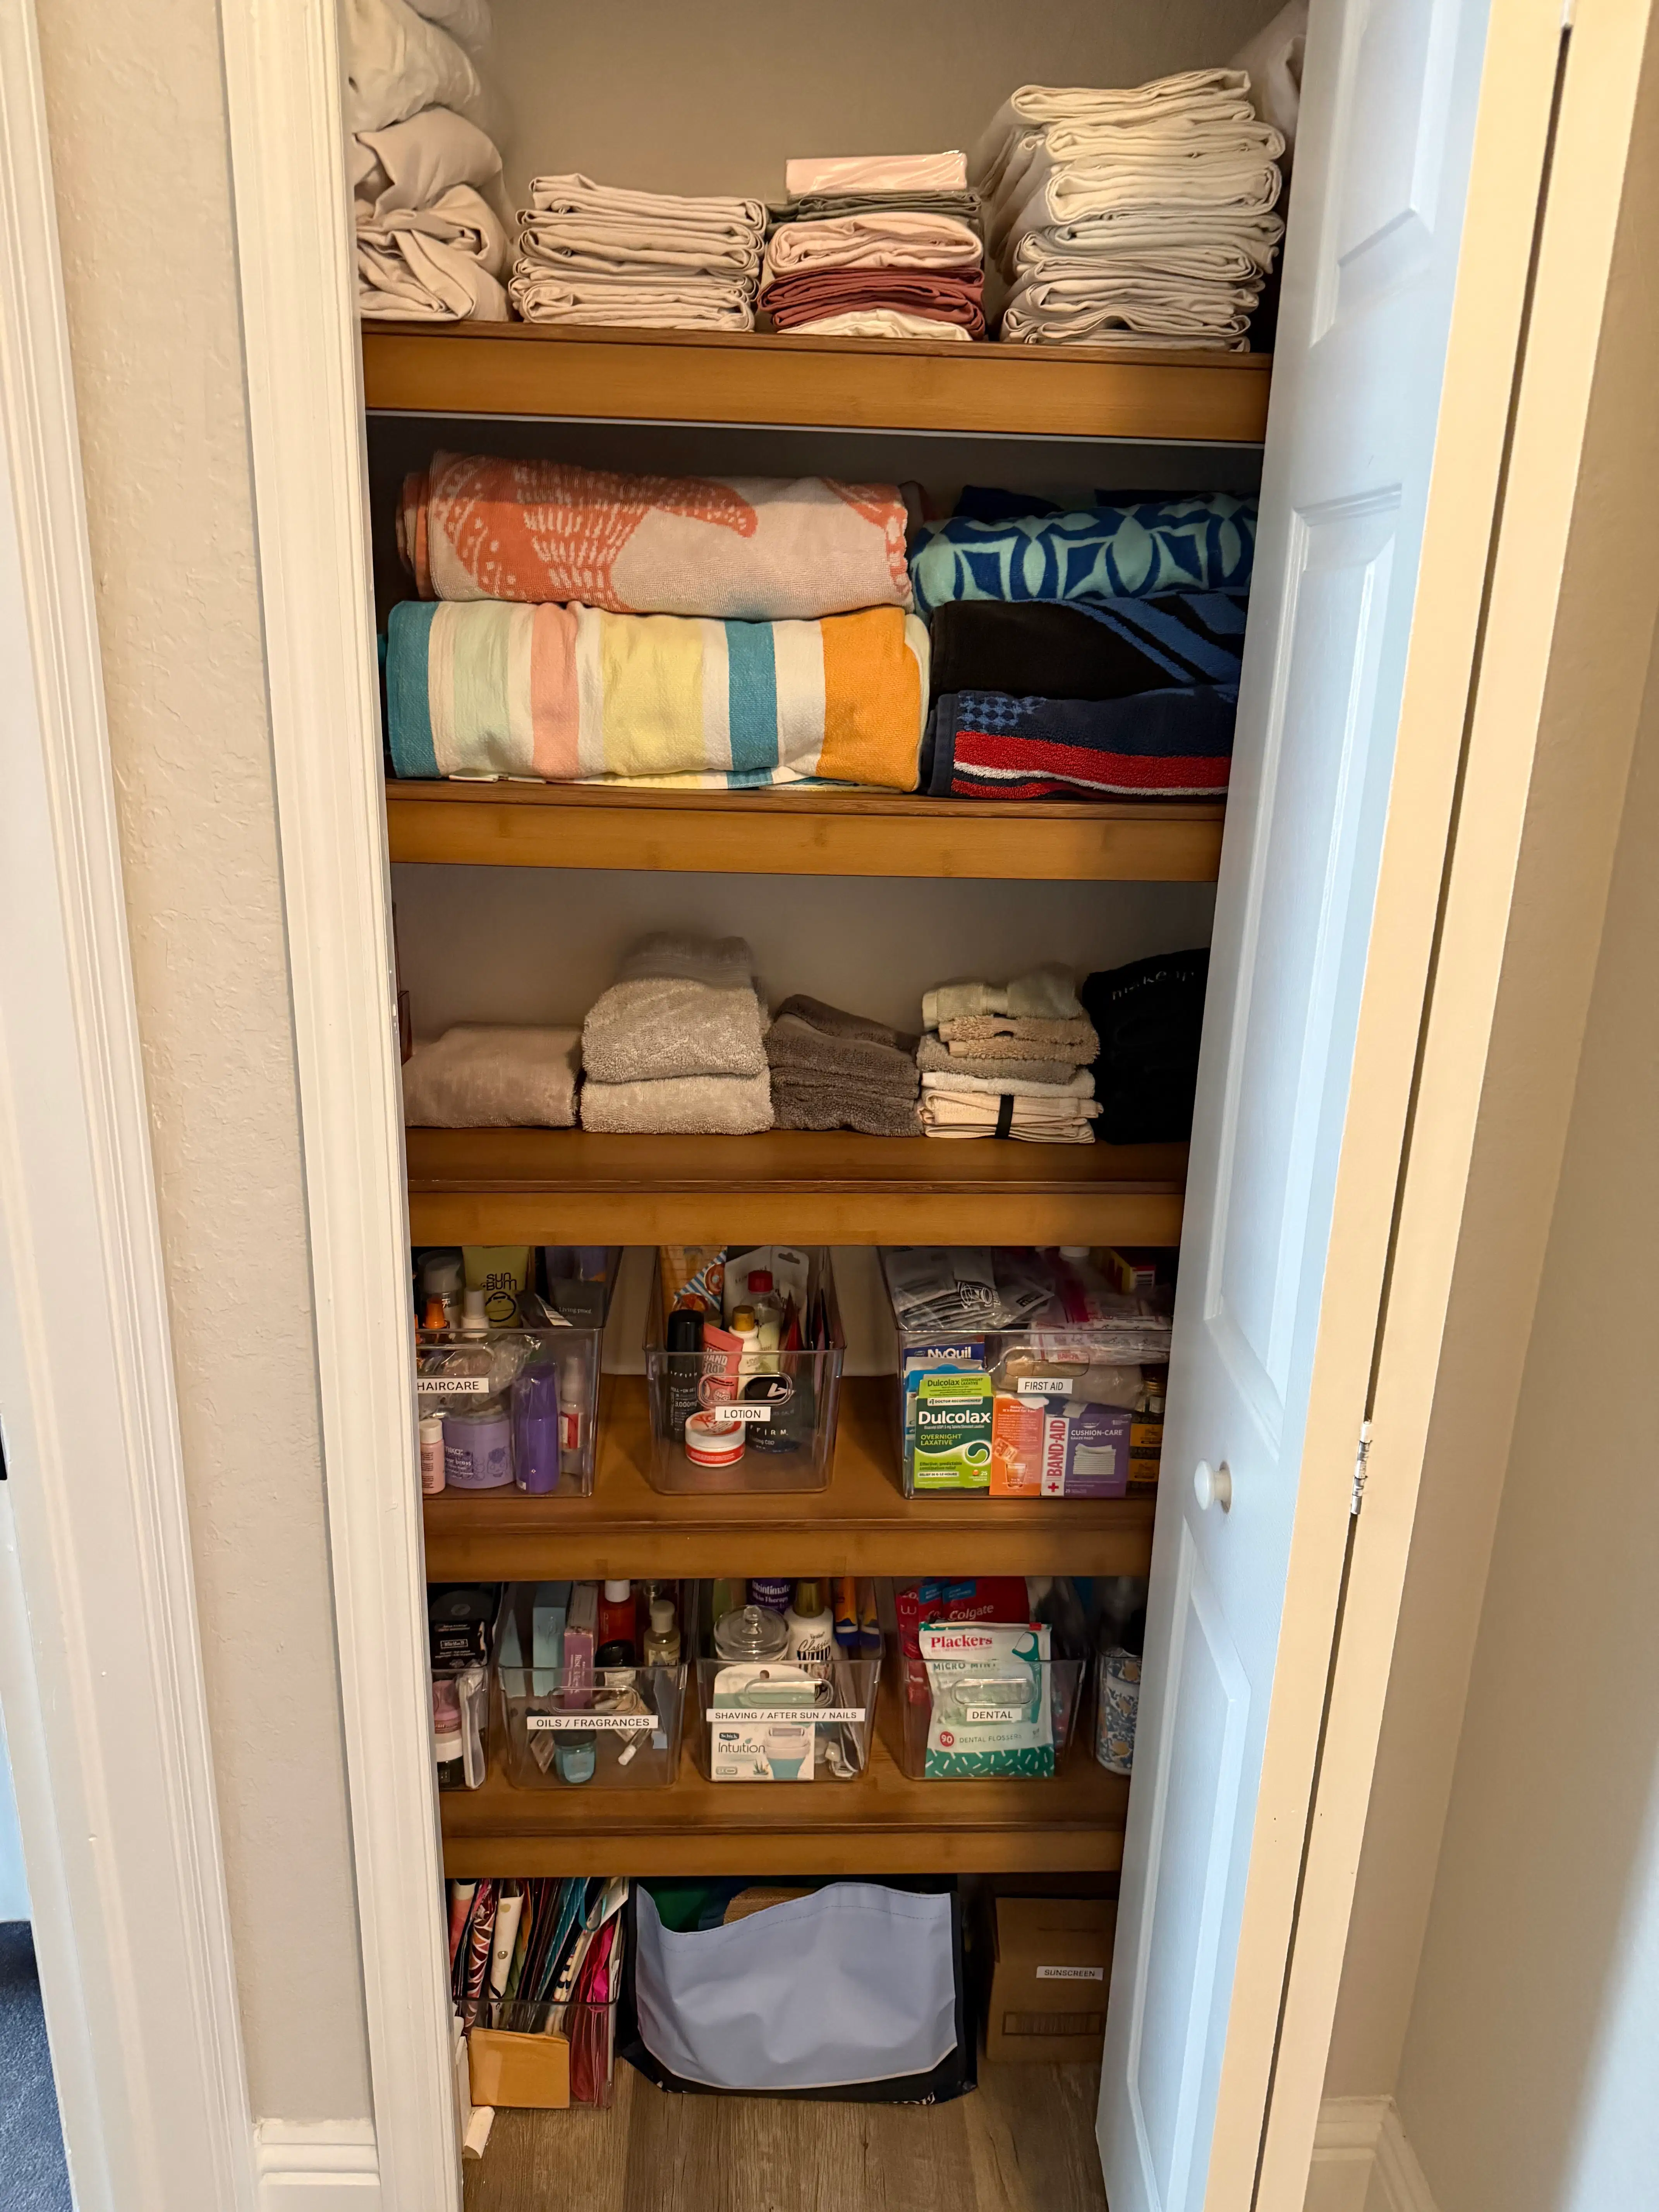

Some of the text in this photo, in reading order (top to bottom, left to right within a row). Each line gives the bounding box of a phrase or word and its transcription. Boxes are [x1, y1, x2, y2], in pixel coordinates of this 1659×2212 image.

[927, 1346, 971, 1358] NyQuil
[417, 1381, 479, 1391] HAIRCARE
[927, 1379, 960, 1387] Dulcolax
[1025, 1382, 1063, 1391] FIRST AID
[724, 1410, 761, 1419] LOTION
[918, 1410, 991, 1425] Dulcolax
[750, 1424, 787, 1436] FFIRM
[948, 1605, 994, 1621] Colgate
[798, 1638, 829, 1653] Classic
[931, 1634, 993, 1648] Plackers
[933, 1662, 966, 1671] MICRO
[972, 1711, 1013, 1719] DENTAL
[536, 1718, 649, 1728] OILS / FRAGRANCES
[941, 1735, 953, 1743] 90
[988, 1733, 1022, 1742] FLOSSERS
[718, 1742, 766, 1753] Intuition
[1044, 1968, 1095, 1977] SUNSCREEN
